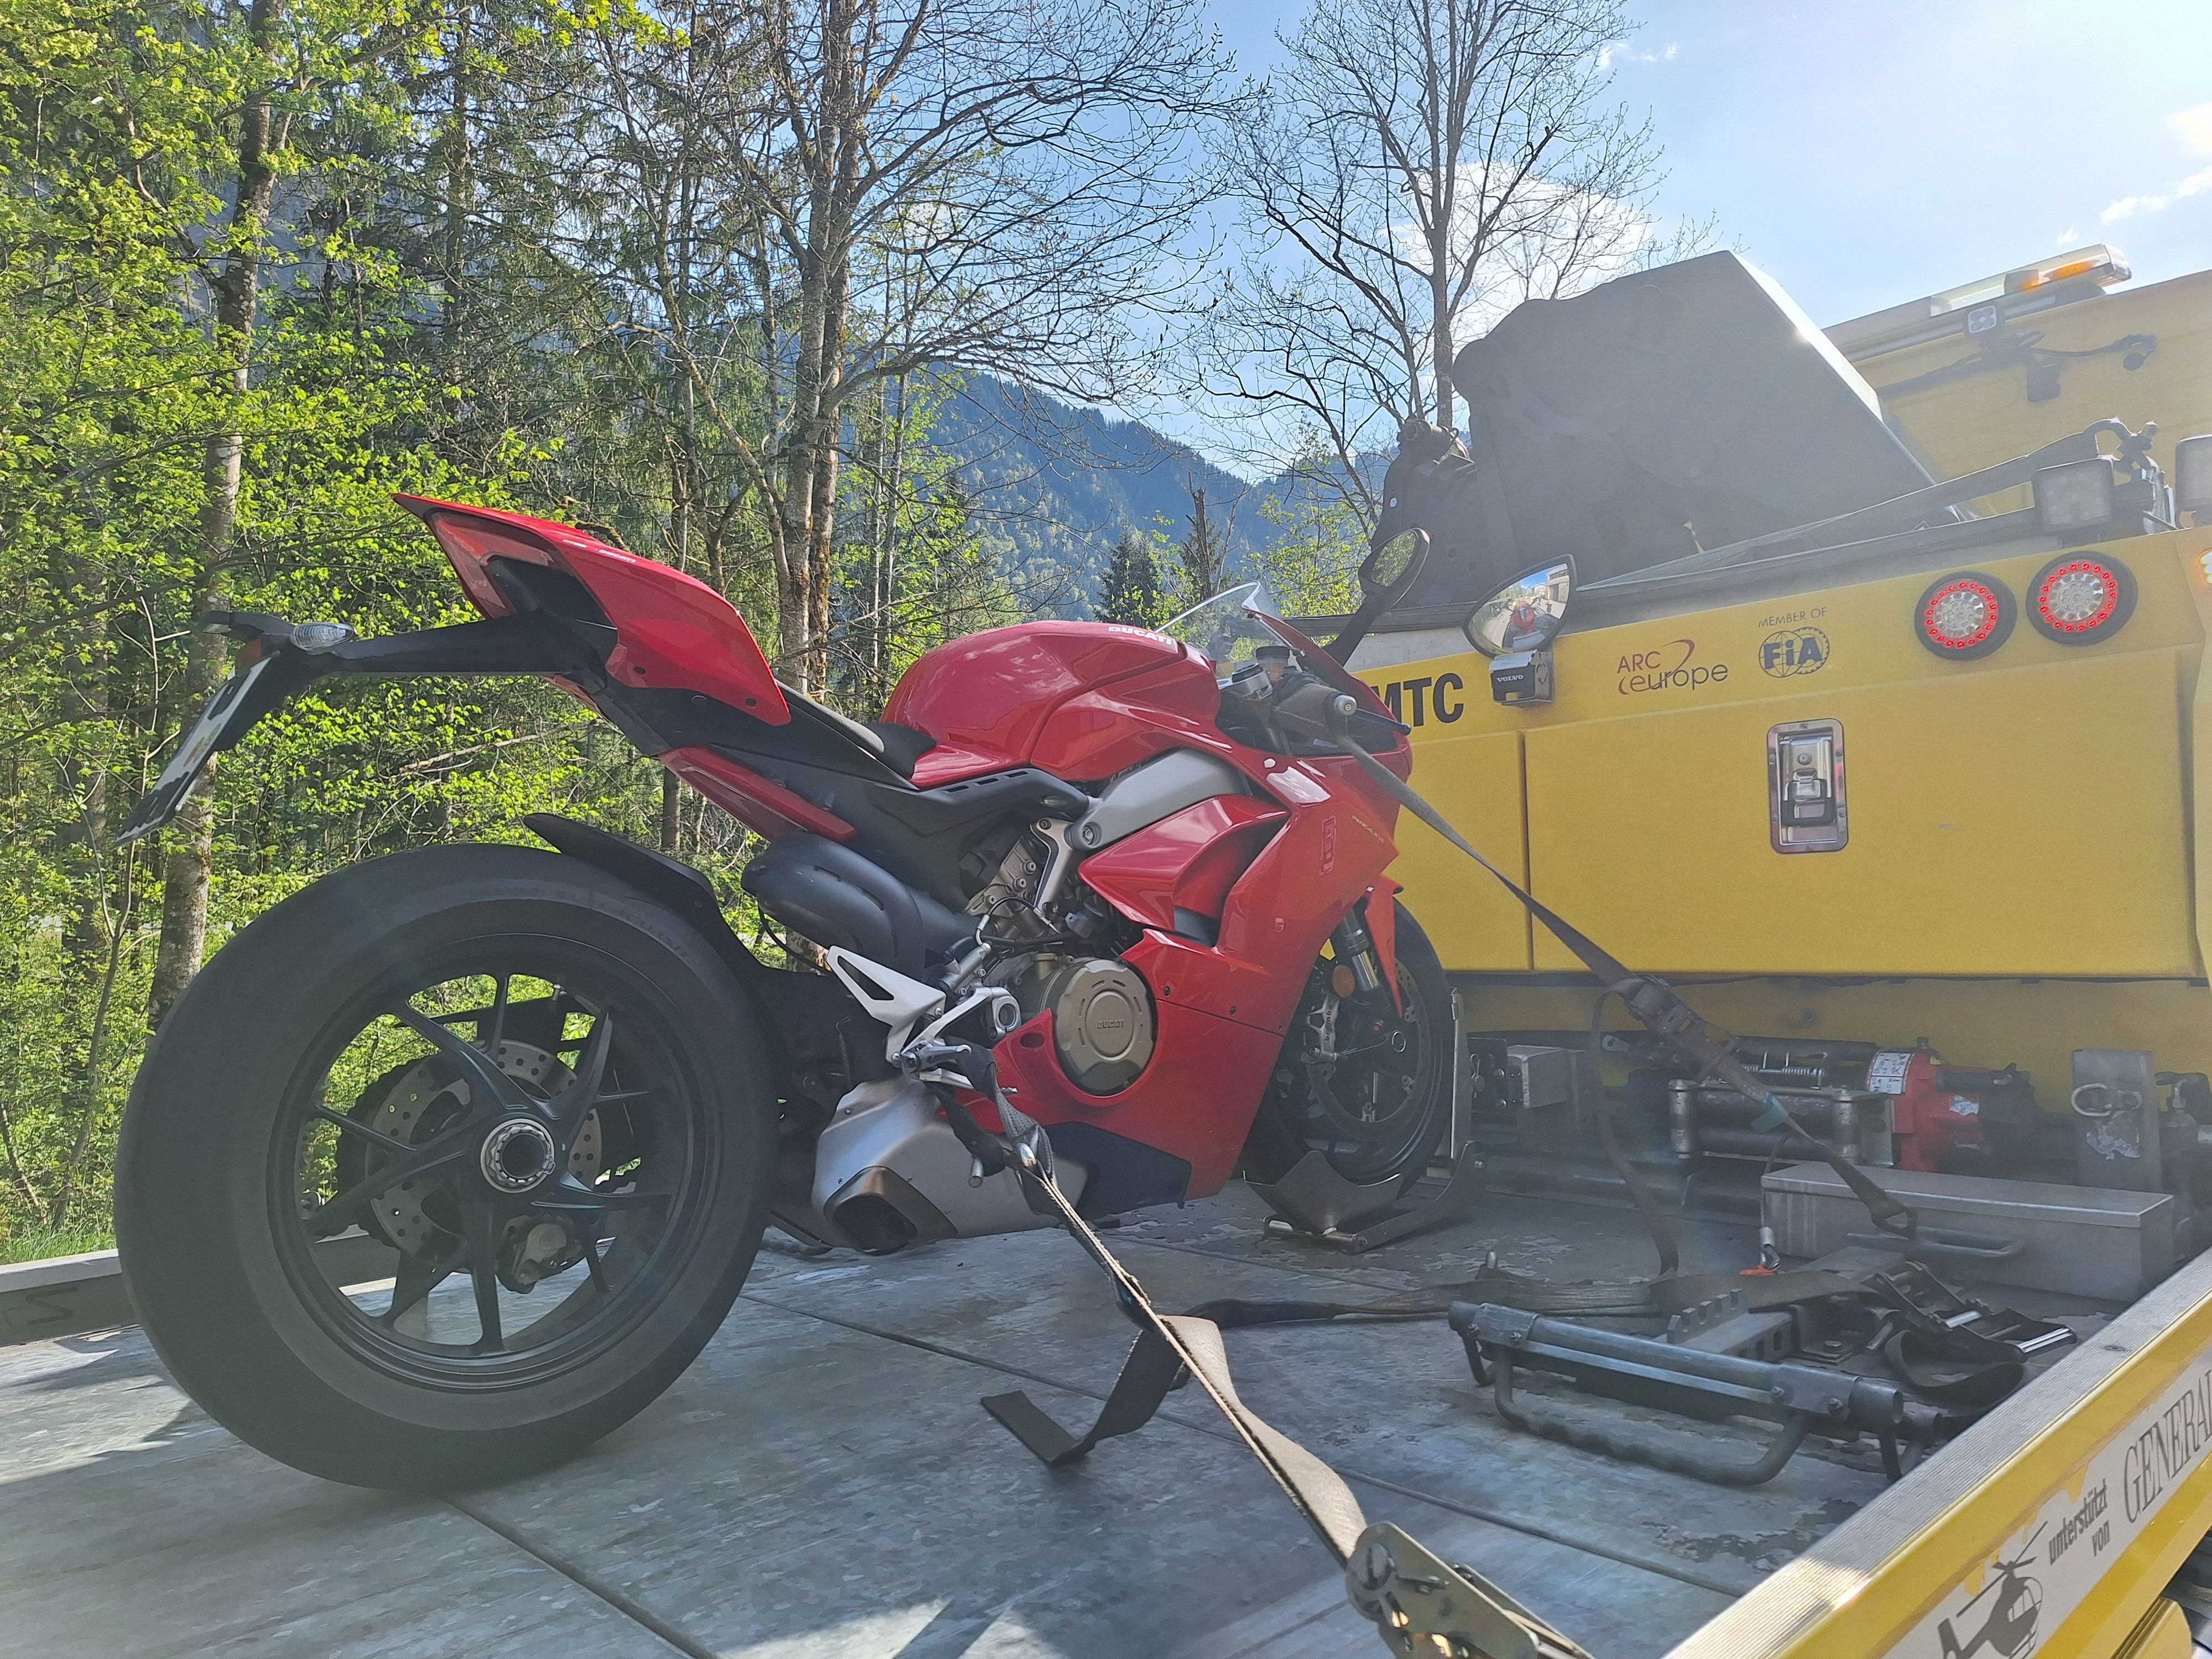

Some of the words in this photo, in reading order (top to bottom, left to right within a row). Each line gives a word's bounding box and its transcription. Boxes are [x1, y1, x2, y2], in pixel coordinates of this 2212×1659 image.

[1759, 611, 1806, 628] MEMBER
[1811, 607, 1827, 618] OF
[1108, 626, 1172, 645] DUCATI
[1616, 651, 1661, 674] ARC
[1496, 674, 1524, 682] VOLVO
[1629, 664, 1728, 692] europe
[1097, 1019, 1125, 1029] DUCATI
[2048, 1478, 2107, 1566] unterstützt
[2092, 1519, 2110, 1557] von
